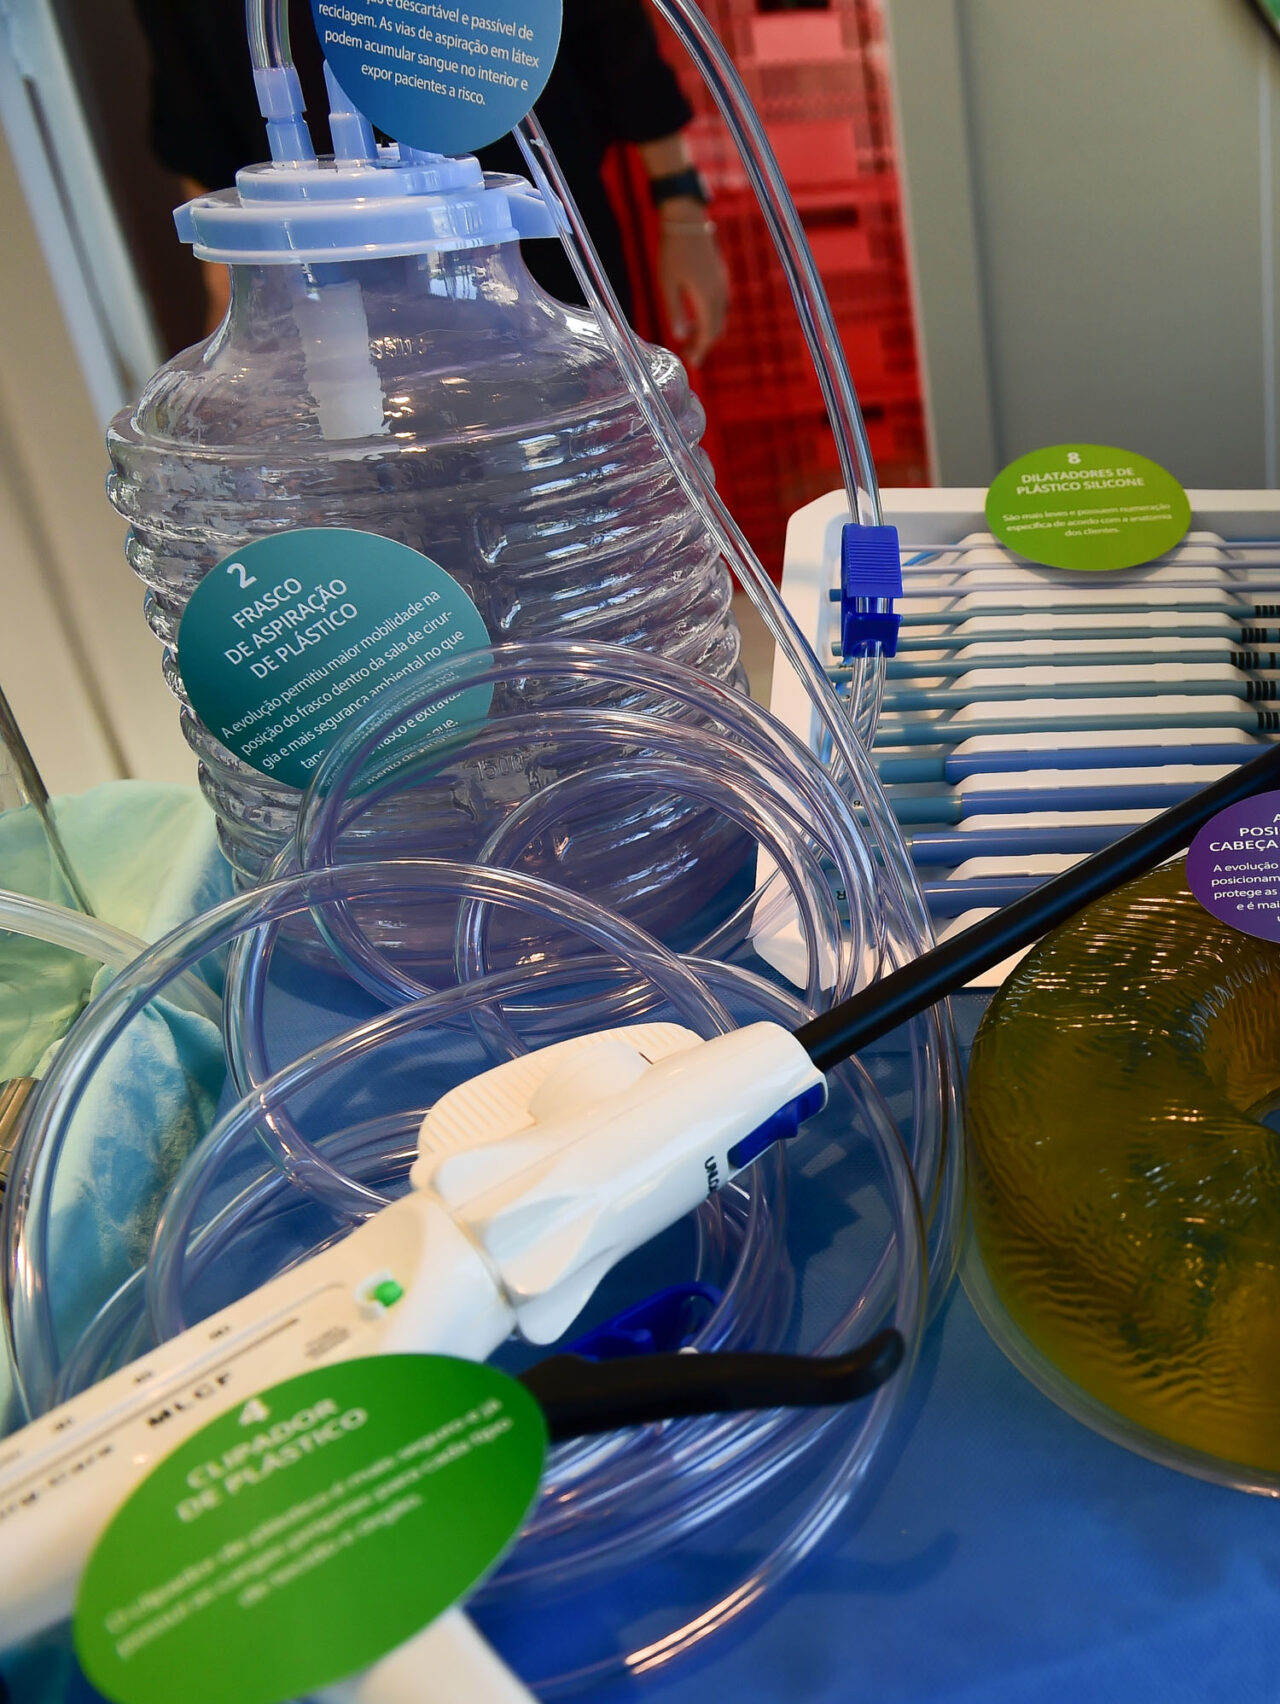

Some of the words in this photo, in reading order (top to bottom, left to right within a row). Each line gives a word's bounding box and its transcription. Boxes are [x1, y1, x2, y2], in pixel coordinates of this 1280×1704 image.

[318, 4, 377, 28] reciclagem.
[379, 16, 393, 31] As
[395, 21, 416, 37] vias
[418, 26, 433, 42] de
[435, 32, 489, 55] aspiração
[491, 47, 509, 61] em
[512, 48, 540, 68] látex
[395, 0, 459, 22] descartável
[462, 15, 469, 25] e
[472, 16, 515, 37] passível
[518, 25, 534, 41] de
[325, 29, 363, 49] podem
[364, 40, 416, 62] acumular
[417, 53, 459, 73] sangue
[460, 65, 476, 78] no
[478, 65, 519, 89] interior
[521, 79, 529, 91] e
[361, 64, 393, 85] expor
[394, 72, 447, 96] pacientes
[449, 85, 456, 97] a
[458, 86, 486, 105] risco.
[1021, 468, 1114, 484] DILATADORES
[1116, 467, 1135, 477] DE
[1067, 452, 1081, 465] 8
[1016, 480, 1081, 495] PLÁSTICO
[1084, 477, 1145, 490] SILICONE
[226, 562, 257, 589] 2
[224, 641, 255, 665] DE
[251, 578, 348, 652] ASPIRAÇÃO
[231, 577, 303, 630] FRASCO
[249, 655, 280, 679] DE
[274, 602, 358, 663] PLÁSTICO
[221, 727, 235, 739] A
[232, 698, 282, 732] evolução
[280, 667, 330, 704] permitiu
[327, 644, 362, 671] maior
[360, 603, 425, 649] mobilidade
[422, 591, 441, 606] na
[240, 724, 284, 756] posição
[282, 714, 300, 728] do
[296, 692, 333, 718] frasco
[331, 667, 370, 696] dentro
[369, 656, 387, 671] da
[384, 641, 409, 661] sala
[407, 630, 425, 645] de
[423, 611, 453, 634] cirur-
[262, 752, 282, 770] gia
[280, 746, 290, 757] e
[287, 731, 316, 752] mais
[423, 646, 442, 662] no
[440, 630, 465, 650] que
[1209, 840, 1279, 853] CABEÇA
[1213, 864, 1222, 872] A
[1224, 861, 1279, 873] evolução
[1214, 888, 1262, 900] protege
[1236, 903, 1244, 911] e
[1247, 900, 1255, 910] é
[237, 1397, 270, 1428] 4
[186, 1397, 339, 1490] CLIPADOR
[175, 1488, 219, 1523] DE
